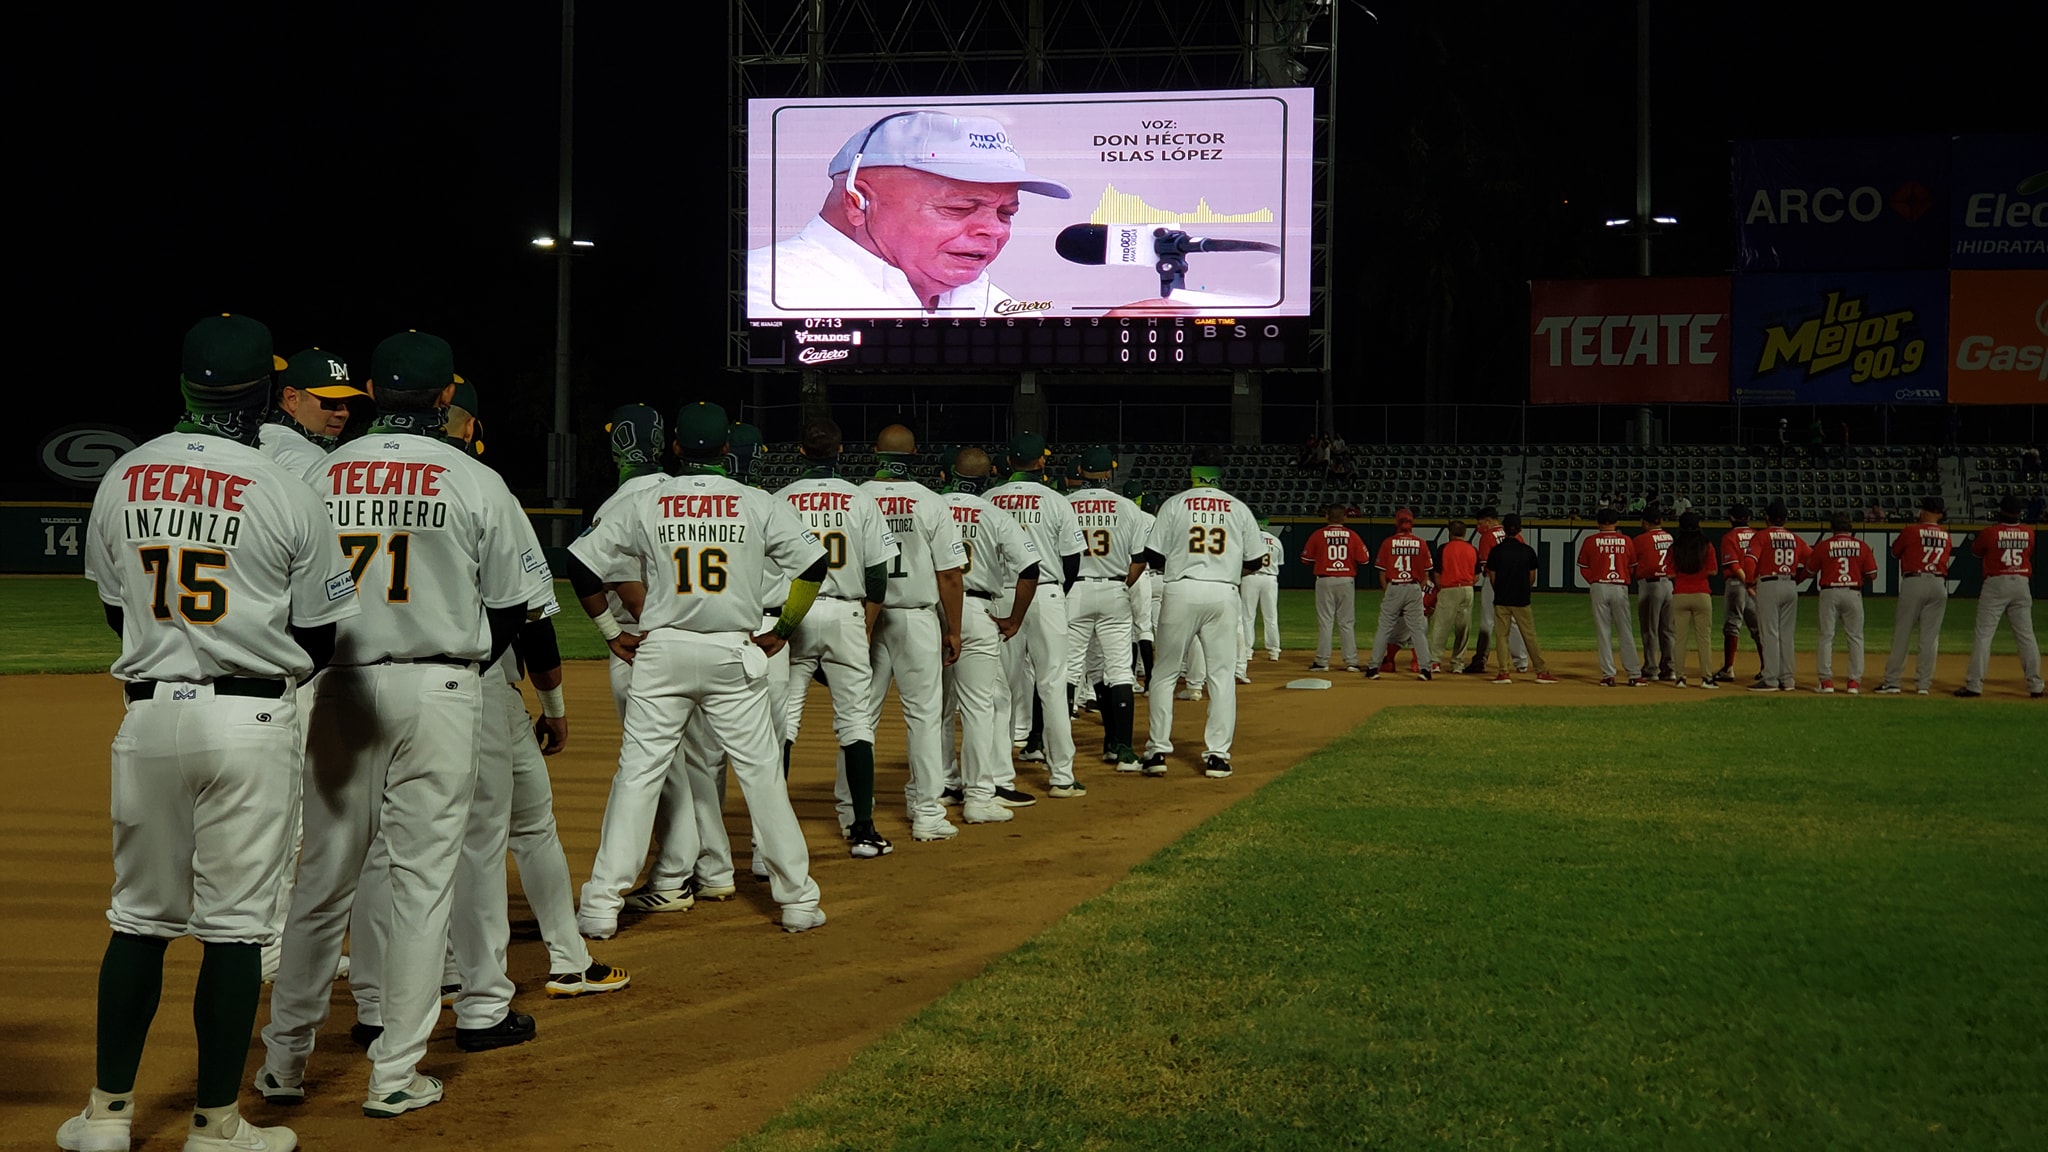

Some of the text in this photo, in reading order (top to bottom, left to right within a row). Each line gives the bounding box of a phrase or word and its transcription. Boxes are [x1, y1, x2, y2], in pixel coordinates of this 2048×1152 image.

[1141, 120, 1177, 129] VOZ:
[1093, 131, 1225, 147] DON HÉCTOR
[1100, 147, 1223, 162] ISLAS LÓPEZ
[1745, 185, 1884, 225] ARCO
[1956, 239, 2048, 255] ¡HIDRATA
[993, 299, 1053, 316] Cañeros
[1824, 290, 1862, 325] la
[805, 318, 842, 328] 07:13
[869, 318, 1184, 328] 1 2 3 4 5 6 7 8 9 C H E
[1203, 325, 1279, 338] B S O
[1121, 330, 1184, 343] 0 0 0
[1533, 313, 1723, 367] TECATE
[1757, 310, 1915, 375] Mejor
[799, 347, 850, 364] Cañeros
[1121, 349, 1184, 362] 0 0 0
[1850, 338, 1926, 384] 90.9
[327, 359, 350, 381] LM
[122, 464, 253, 512] TECATE
[327, 461, 447, 497] TECATE
[657, 495, 740, 519] TECATE
[875, 496, 919, 516] CATE
[1184, 497, 1232, 513] TECATE
[800, 512, 843, 528] UGO
[949, 506, 982, 524] ATE
[1077, 515, 1118, 527] ARIBAY
[1192, 512, 1225, 525] COTA
[124, 507, 241, 546] INZUNZA
[657, 521, 746, 545] HERNÁNDEZ
[44, 525, 79, 556] 14
[1081, 529, 1110, 557] 13
[1187, 525, 1227, 556] 23
[1327, 545, 1348, 560] 00
[1658, 550, 1668, 565] 7
[1774, 548, 1795, 566] 88
[1921, 547, 1945, 565] 77
[2001, 549, 2023, 566] 45
[338, 532, 410, 604] 71
[672, 545, 729, 595] 16
[1394, 555, 1411, 572] 41
[1608, 553, 1616, 571] 1
[1837, 557, 1849, 575] 3
[138, 545, 229, 625] 75
